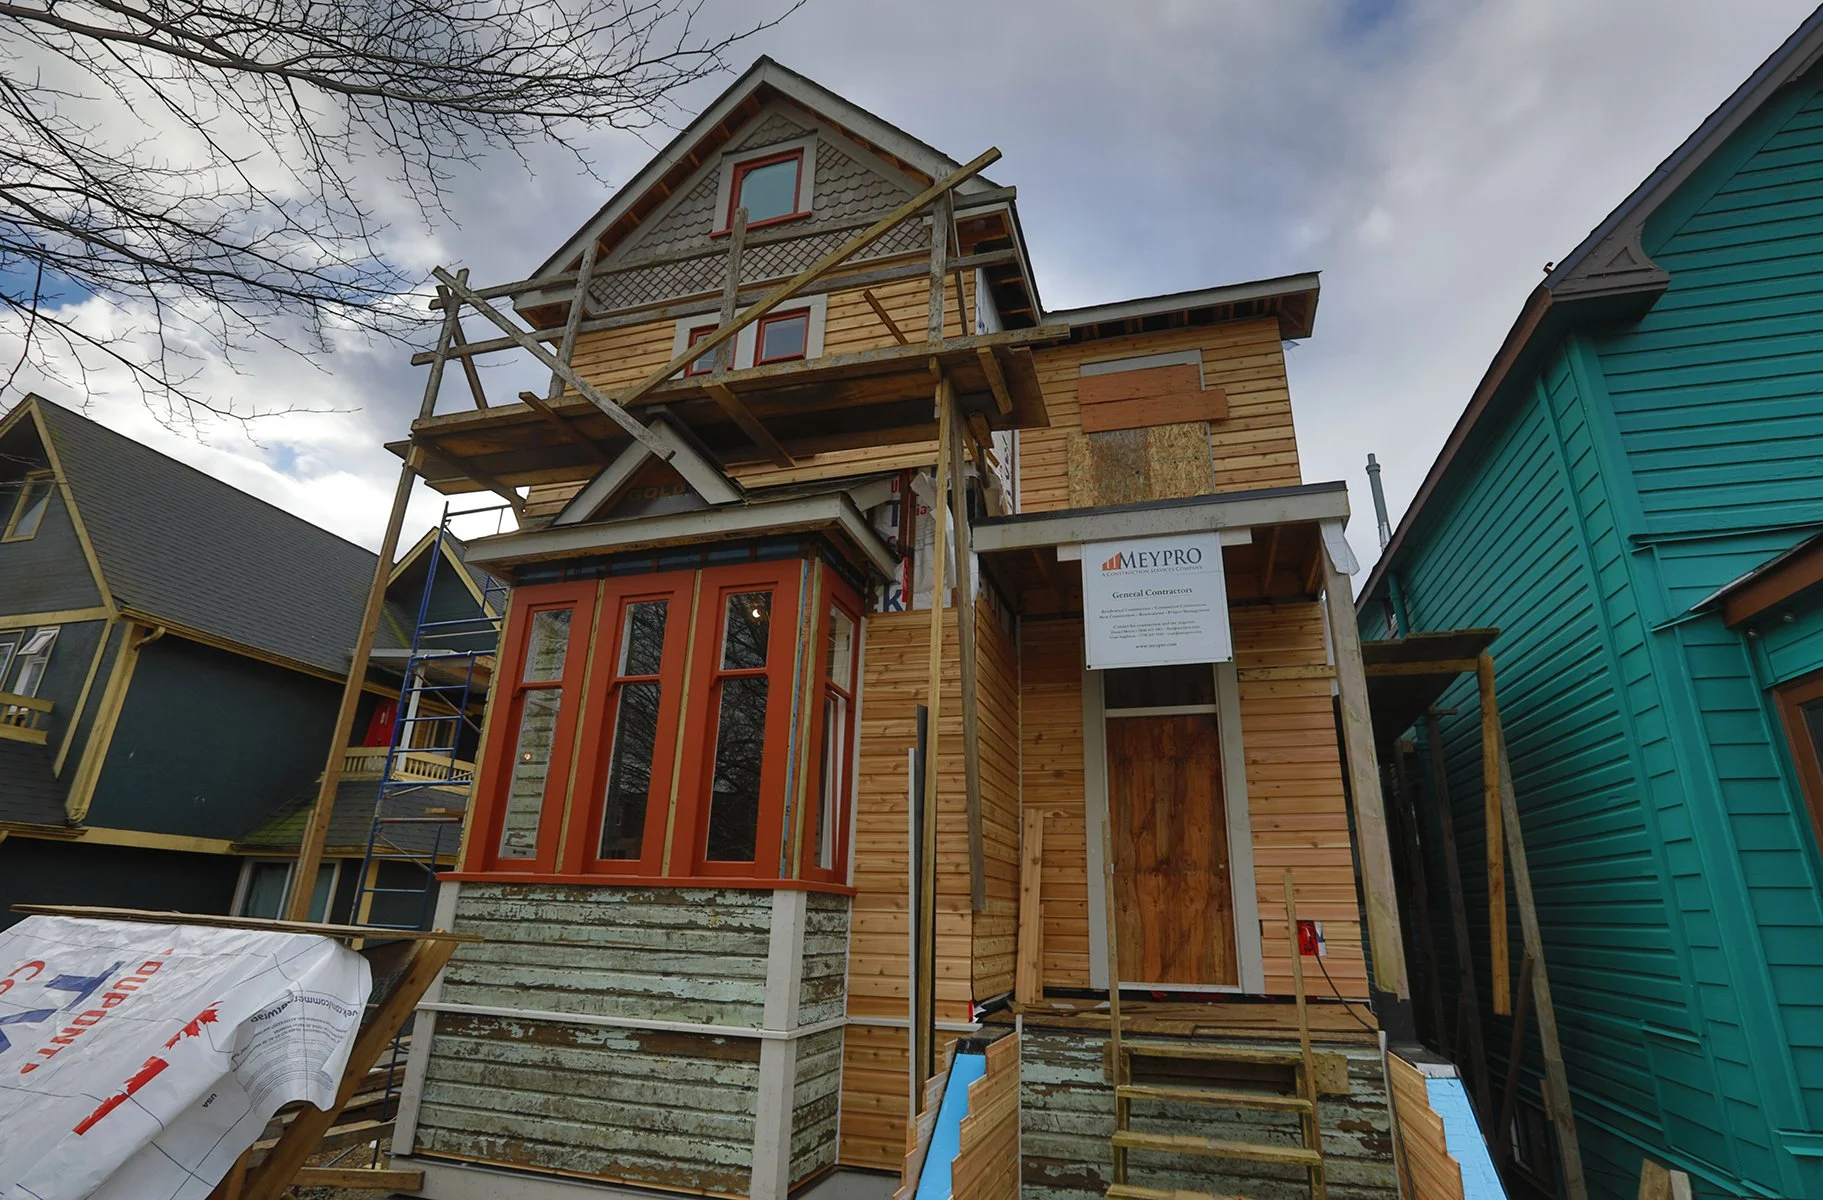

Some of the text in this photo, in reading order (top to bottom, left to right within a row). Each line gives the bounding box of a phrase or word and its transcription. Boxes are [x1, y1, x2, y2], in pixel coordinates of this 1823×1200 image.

[1119, 547, 1203, 570] MEYPRO
[1112, 587, 1193, 599] General Contractors
[36, 960, 164, 1060] DUPONT
[202, 1093, 218, 1109] USA
